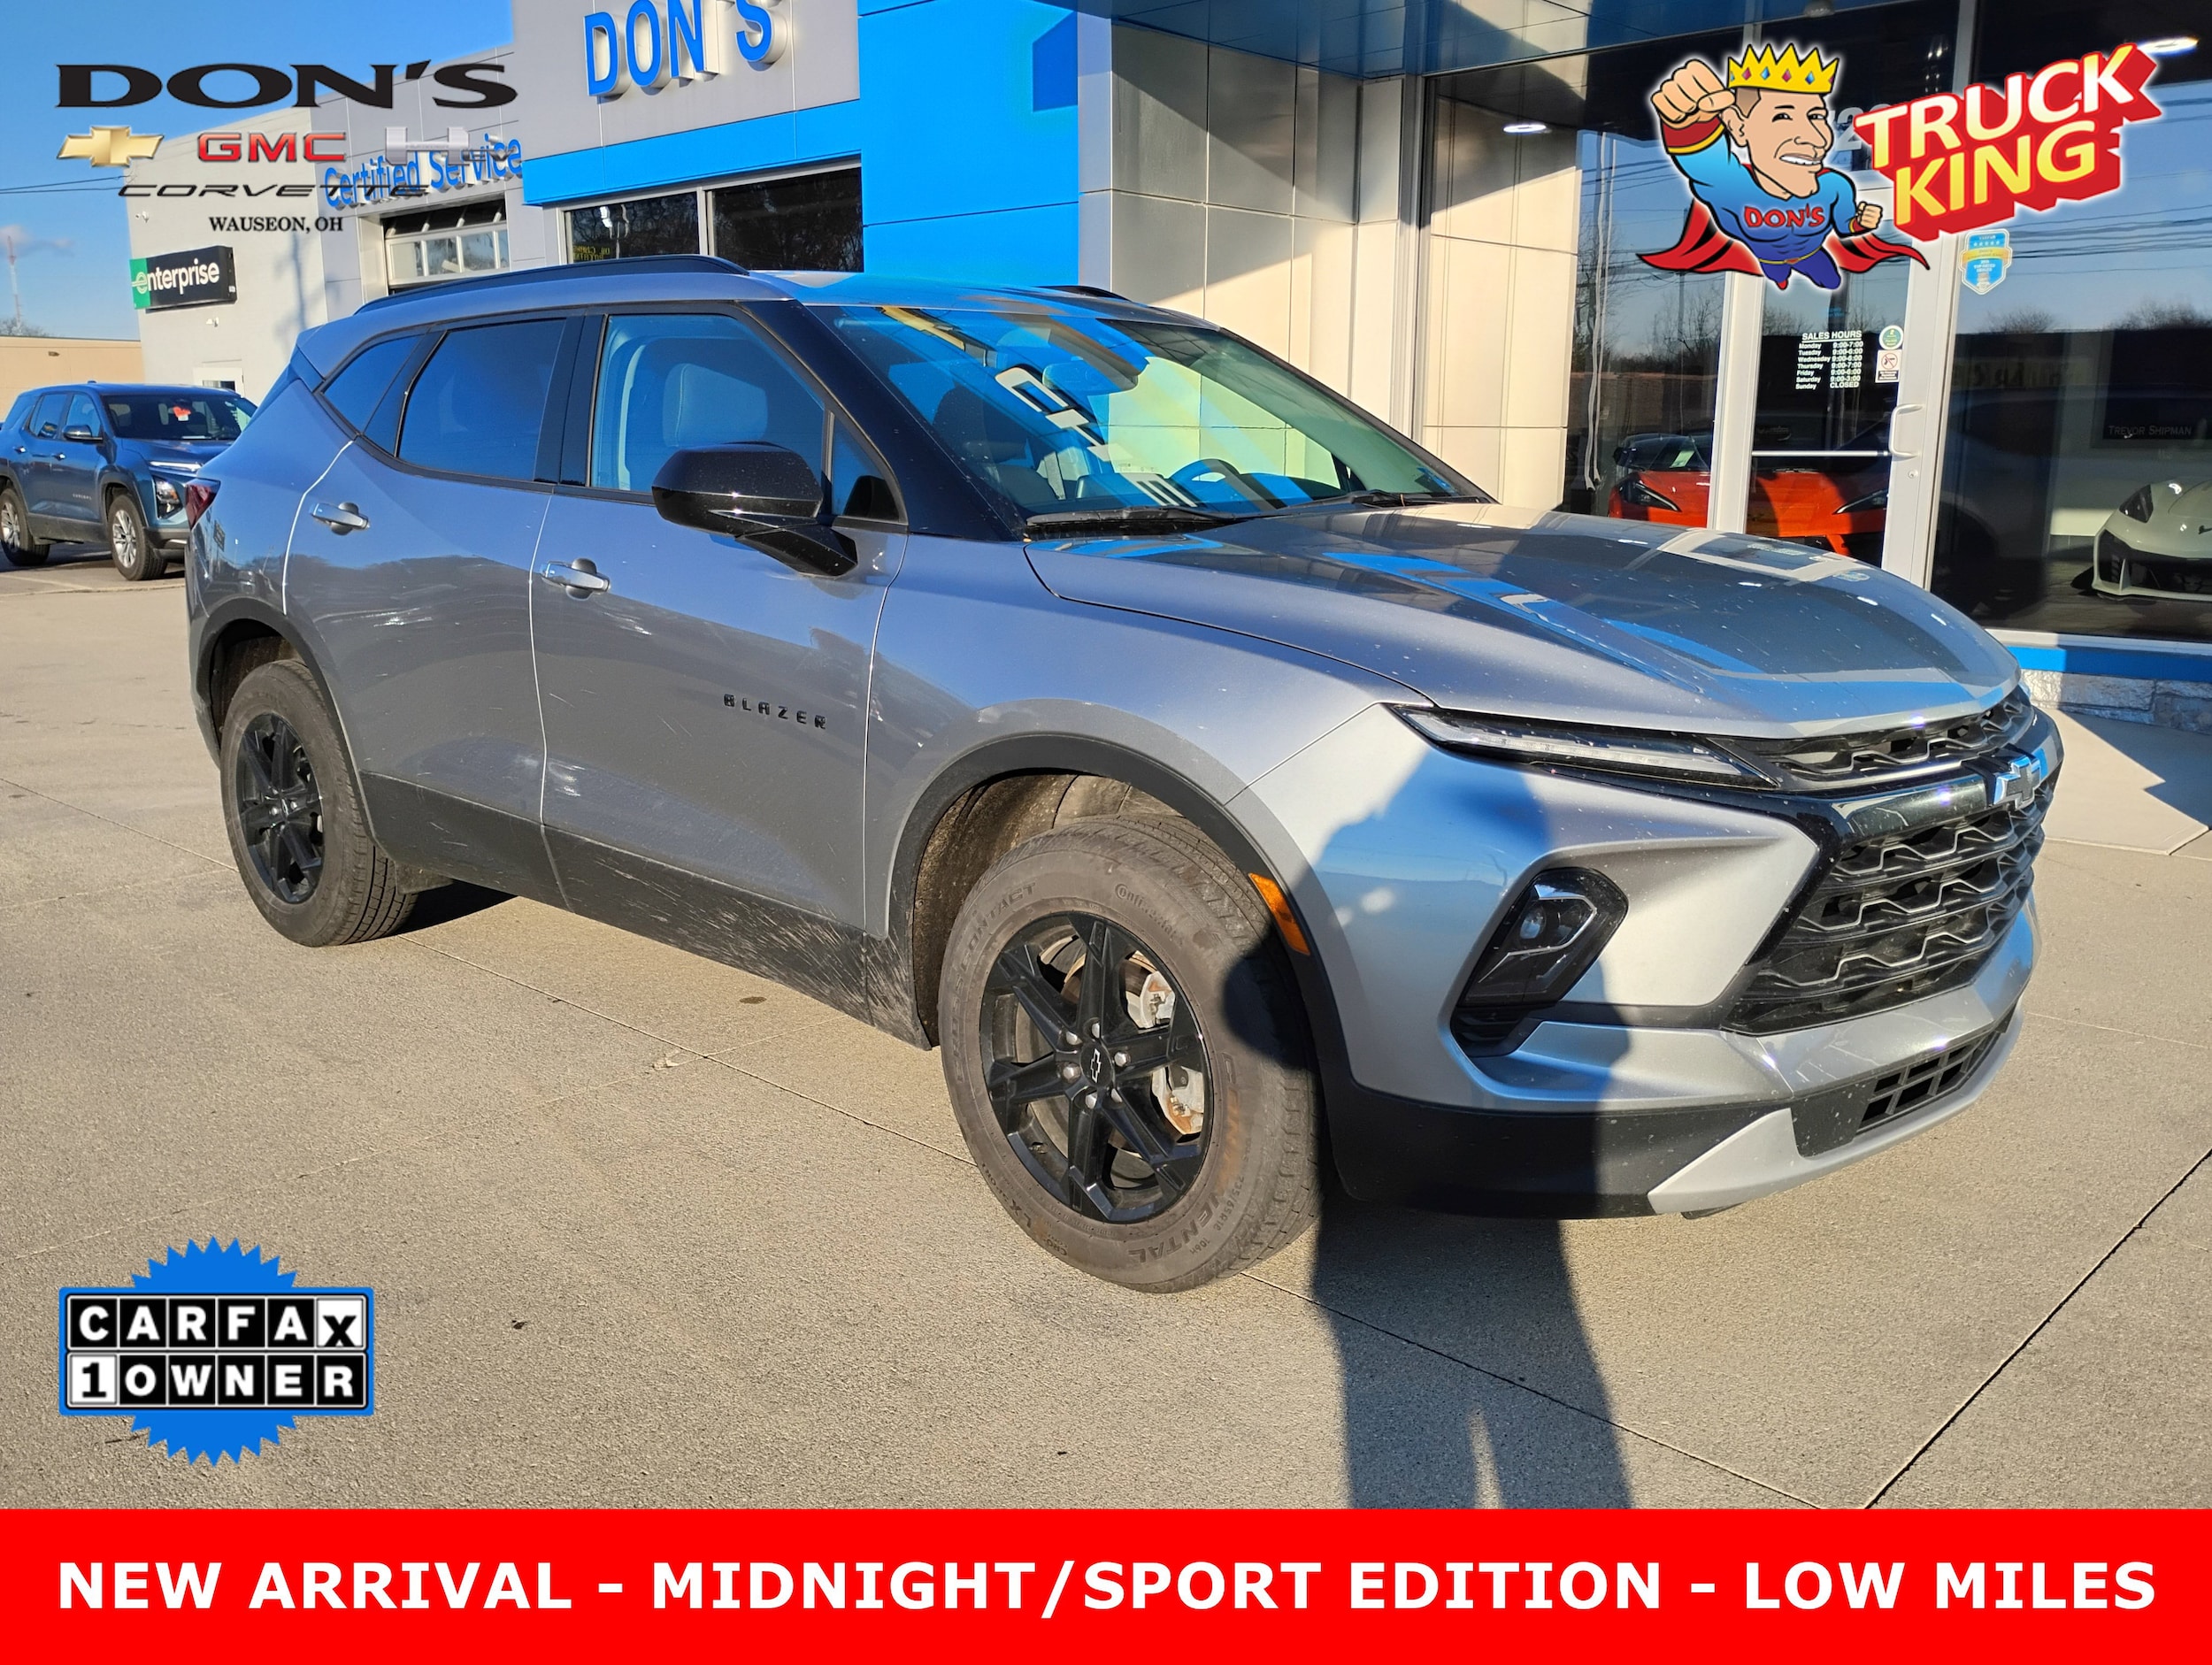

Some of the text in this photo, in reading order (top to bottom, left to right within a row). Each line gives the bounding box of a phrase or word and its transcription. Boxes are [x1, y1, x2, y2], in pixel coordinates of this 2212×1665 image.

[584, 0, 773, 96] DONS
[324, 133, 522, 207] Certified Service
[132, 257, 220, 295] enterprise
[1801, 330, 1863, 341] SALES HOURS
[2108, 425, 2193, 436] TREVOR SHIPMAN
[724, 694, 826, 730] BLAZER
